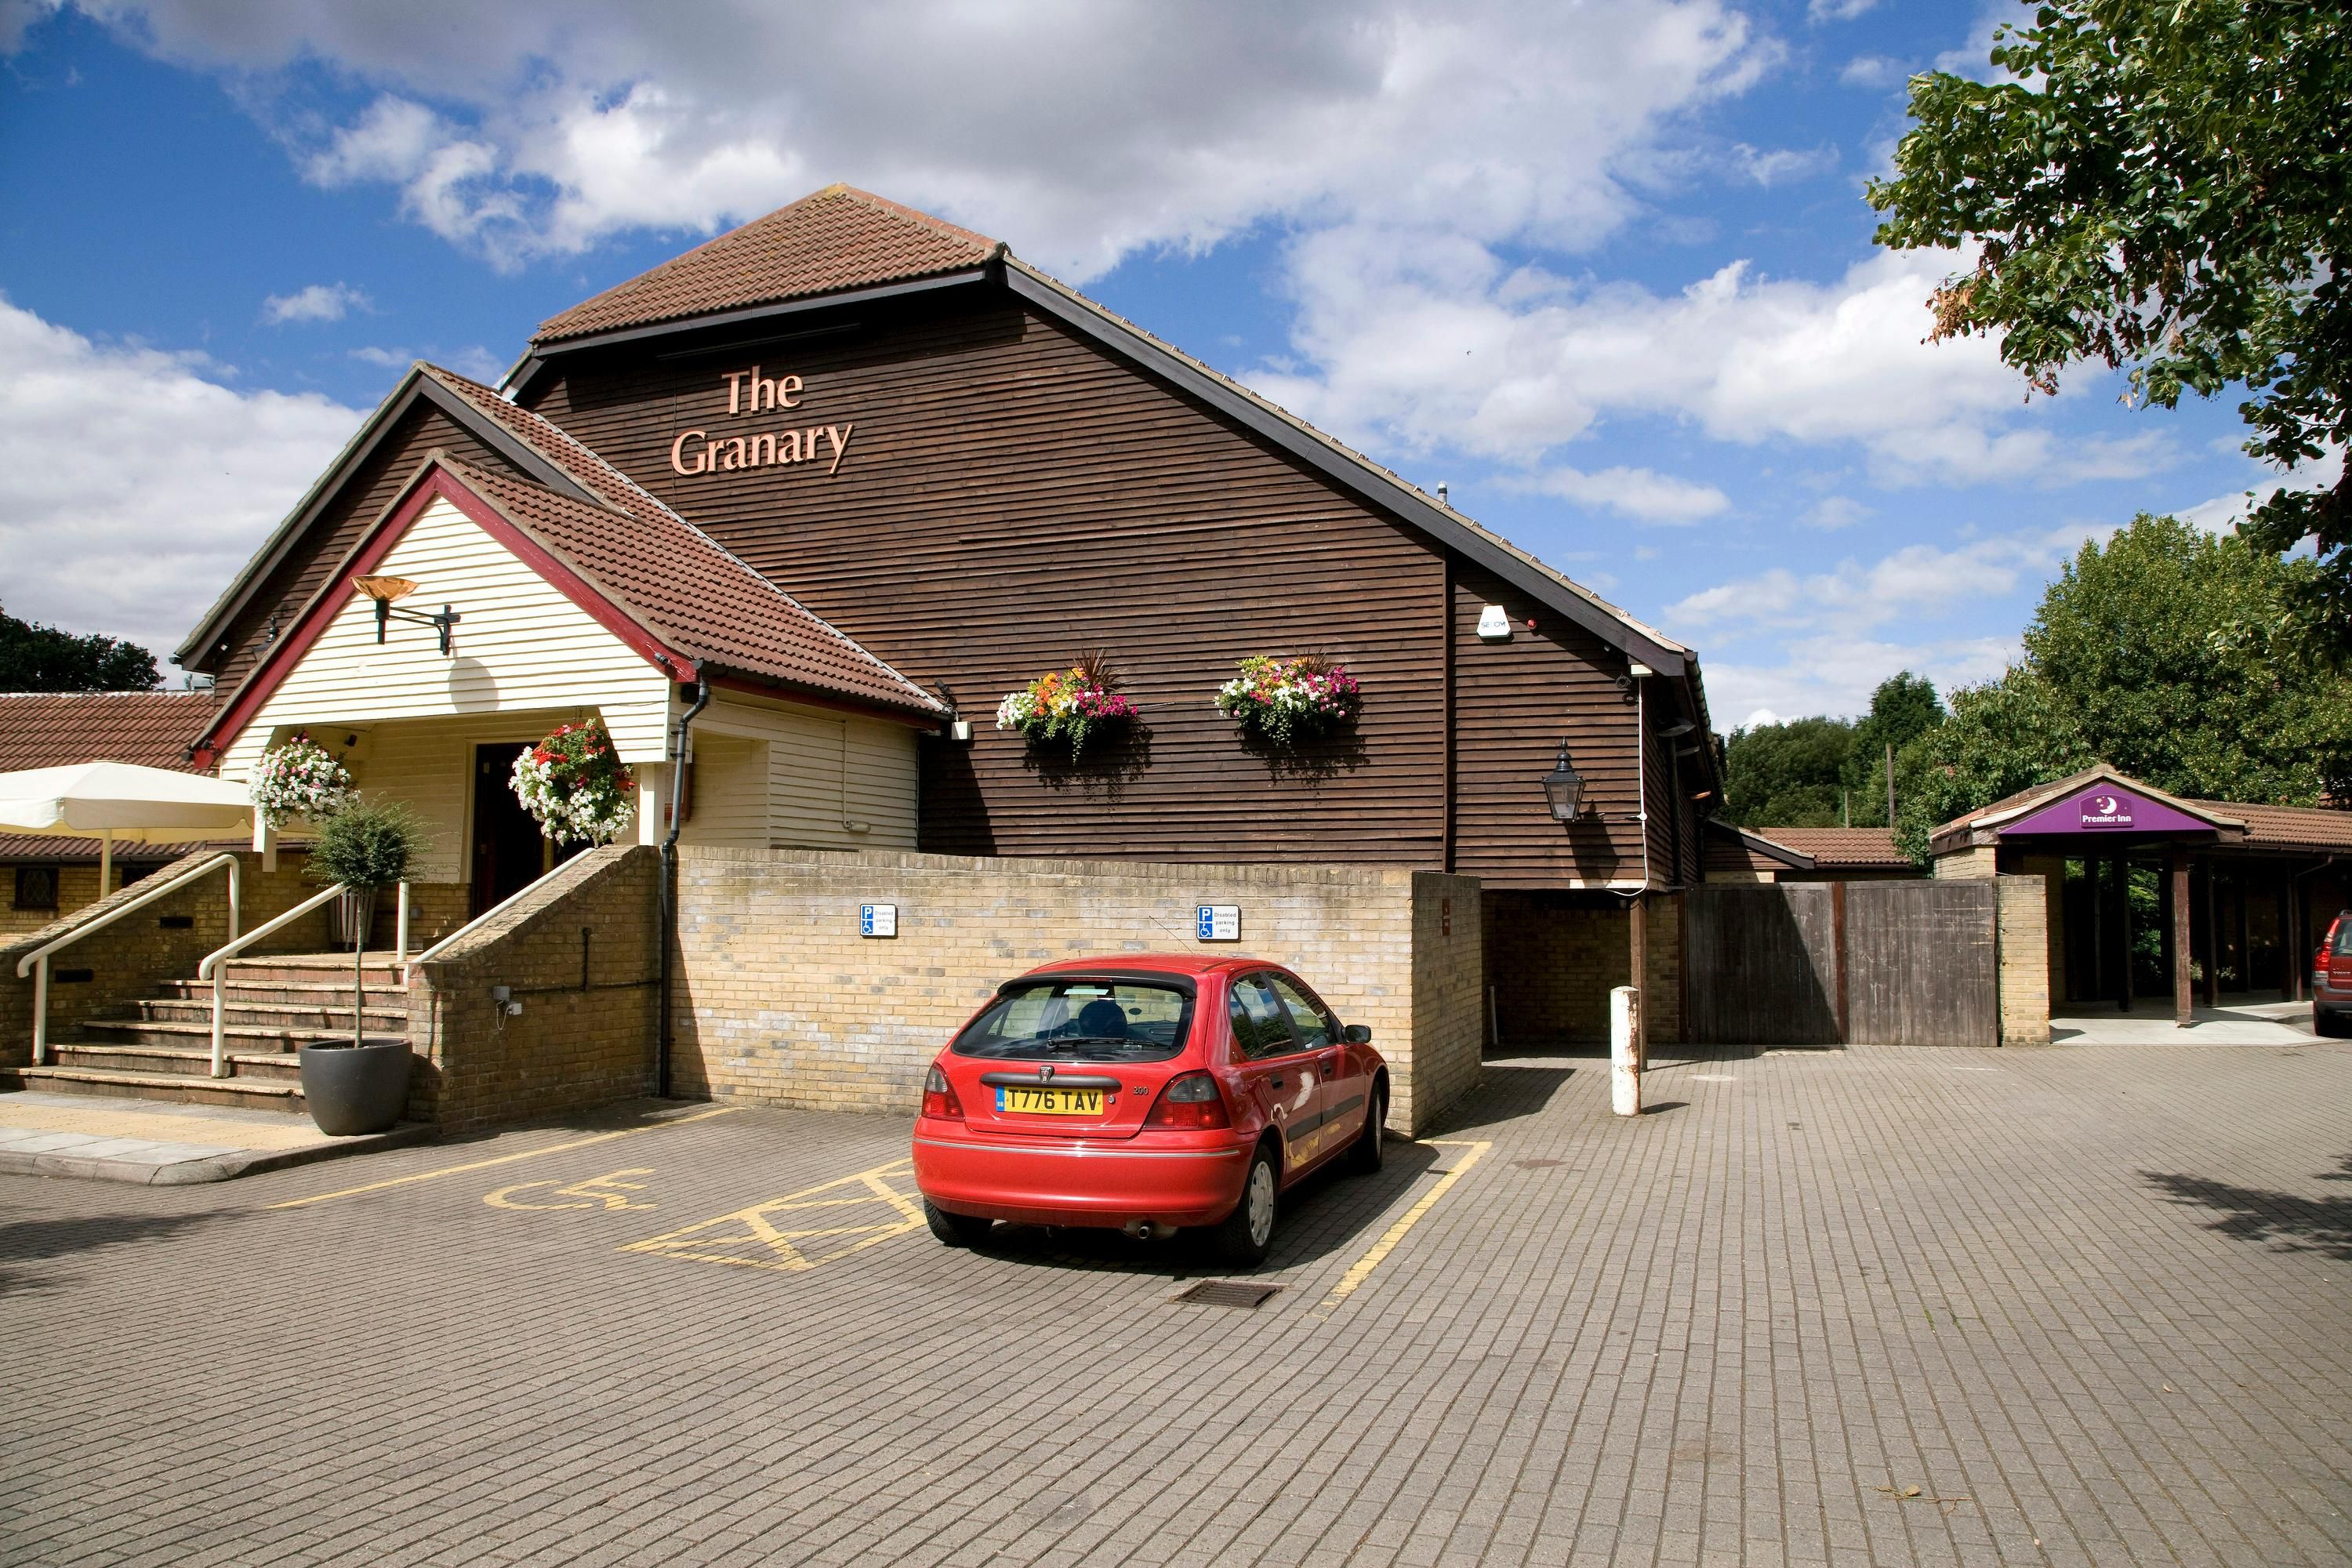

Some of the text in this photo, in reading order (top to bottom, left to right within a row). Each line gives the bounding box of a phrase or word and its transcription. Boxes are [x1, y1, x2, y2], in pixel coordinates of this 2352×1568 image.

[721, 364, 805, 416] The
[671, 423, 855, 477] Granary
[865, 907, 872, 918] P
[1202, 909, 1210, 920] P
[1133, 1086, 1149, 1095] 200
[1008, 1089, 1098, 1110] T776 TAV
